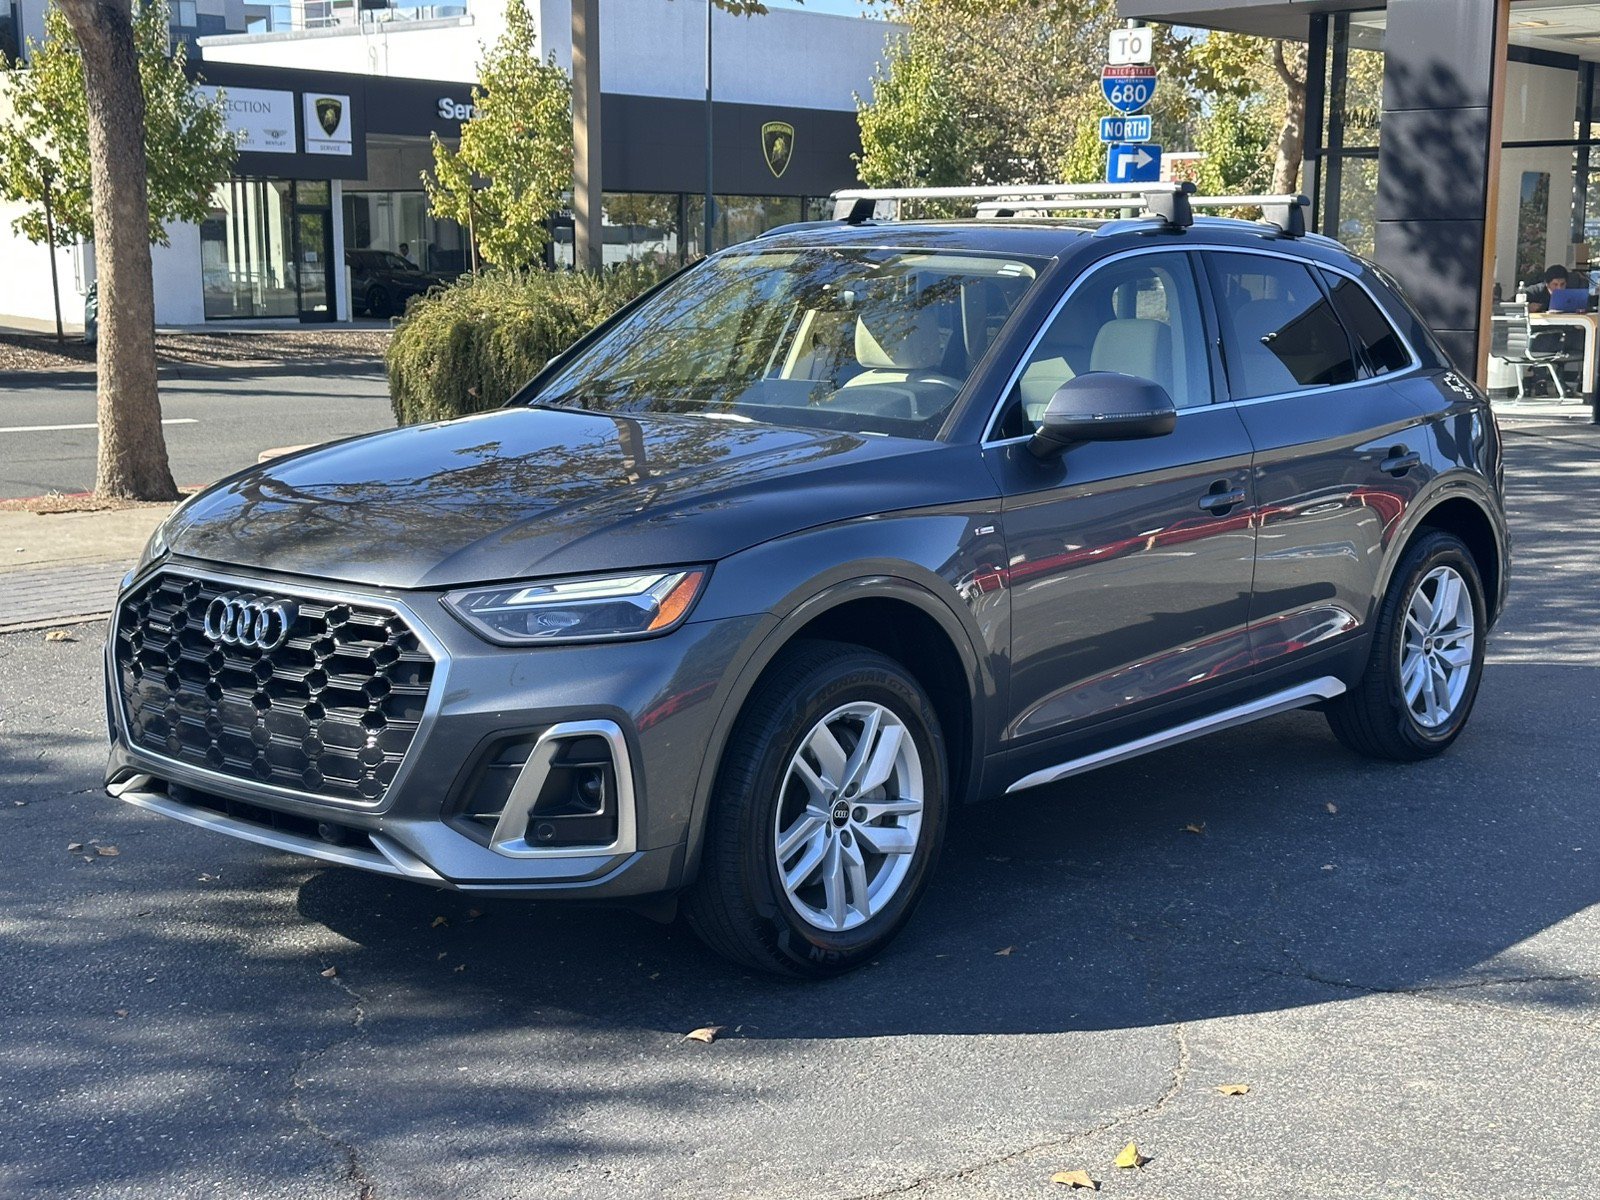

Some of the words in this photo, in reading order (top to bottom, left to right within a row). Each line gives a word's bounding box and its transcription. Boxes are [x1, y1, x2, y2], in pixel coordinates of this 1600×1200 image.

[1118, 37, 1142, 55] TO
[1107, 68, 1151, 76] INTERSTATE
[1111, 84, 1147, 103] 680
[1105, 120, 1147, 137] NORTH
